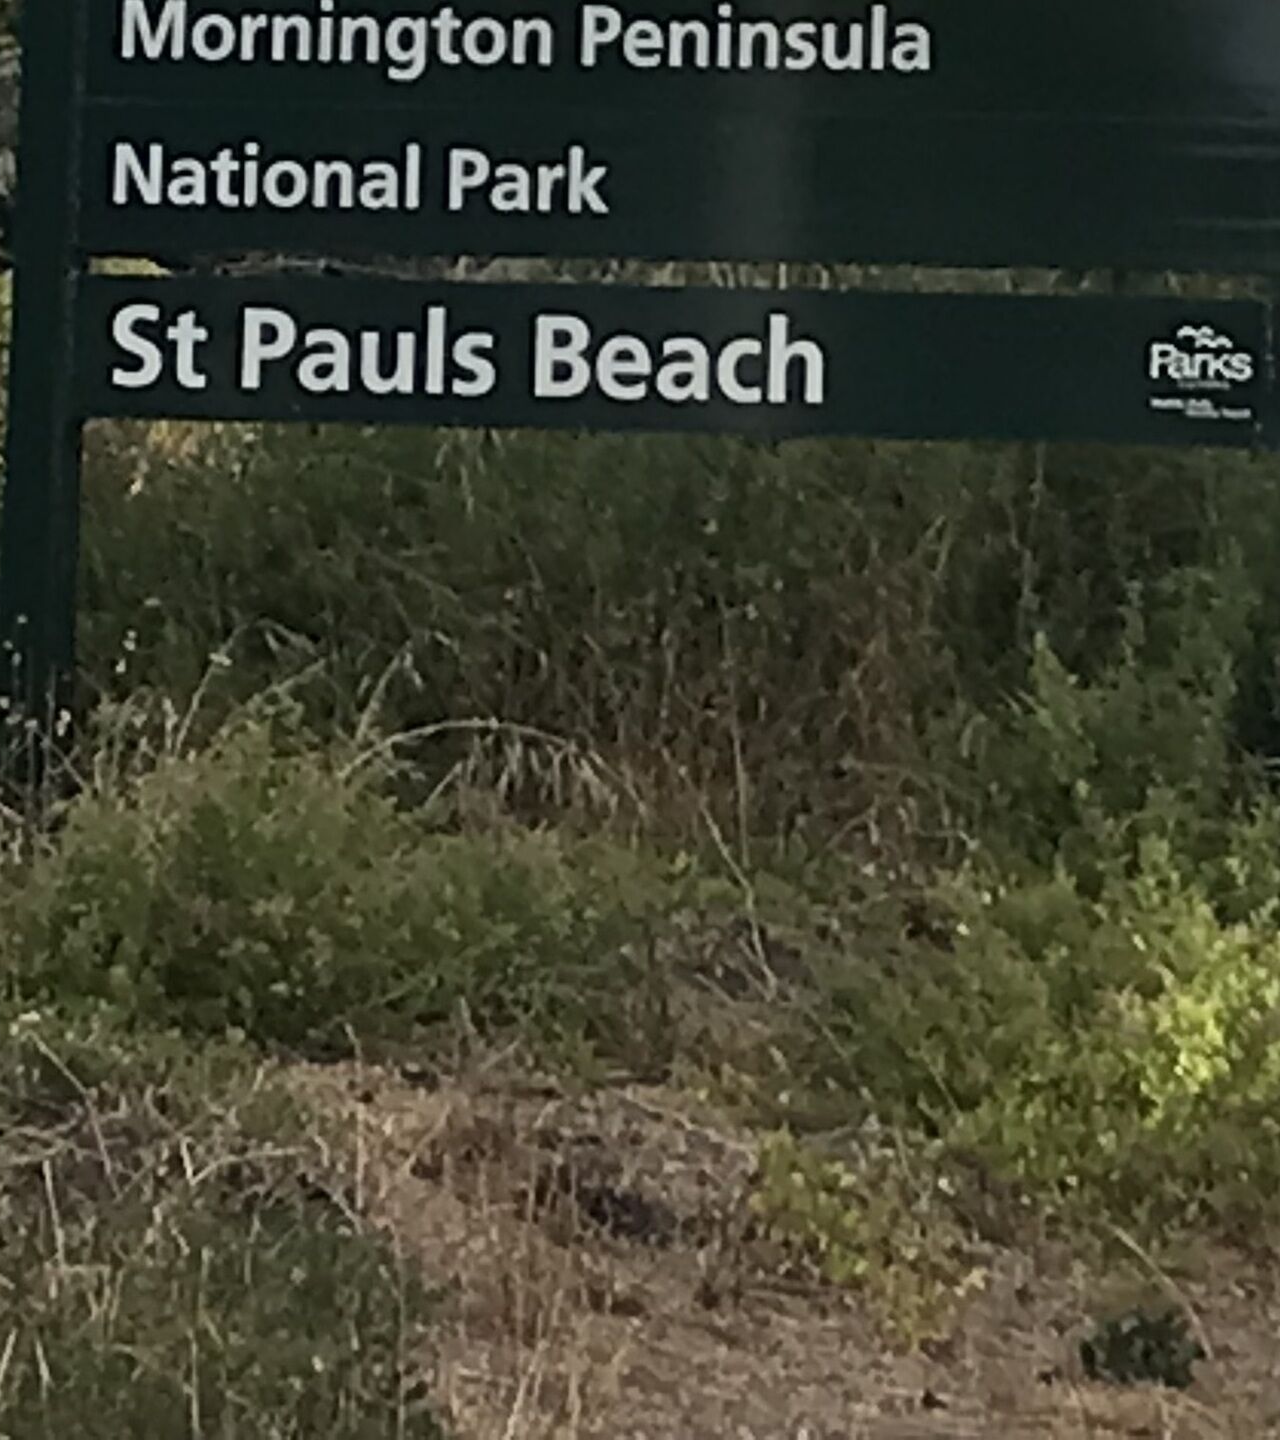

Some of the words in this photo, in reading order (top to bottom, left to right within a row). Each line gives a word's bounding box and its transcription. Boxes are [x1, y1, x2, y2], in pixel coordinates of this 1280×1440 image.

[580, 3, 930, 71] Peninsula
[112, 142, 420, 210] National
[448, 145, 609, 214] Park
[112, 304, 208, 389] St
[241, 306, 496, 396] Pauls
[534, 313, 824, 404] Beach
[1149, 342, 1253, 381] Parks
